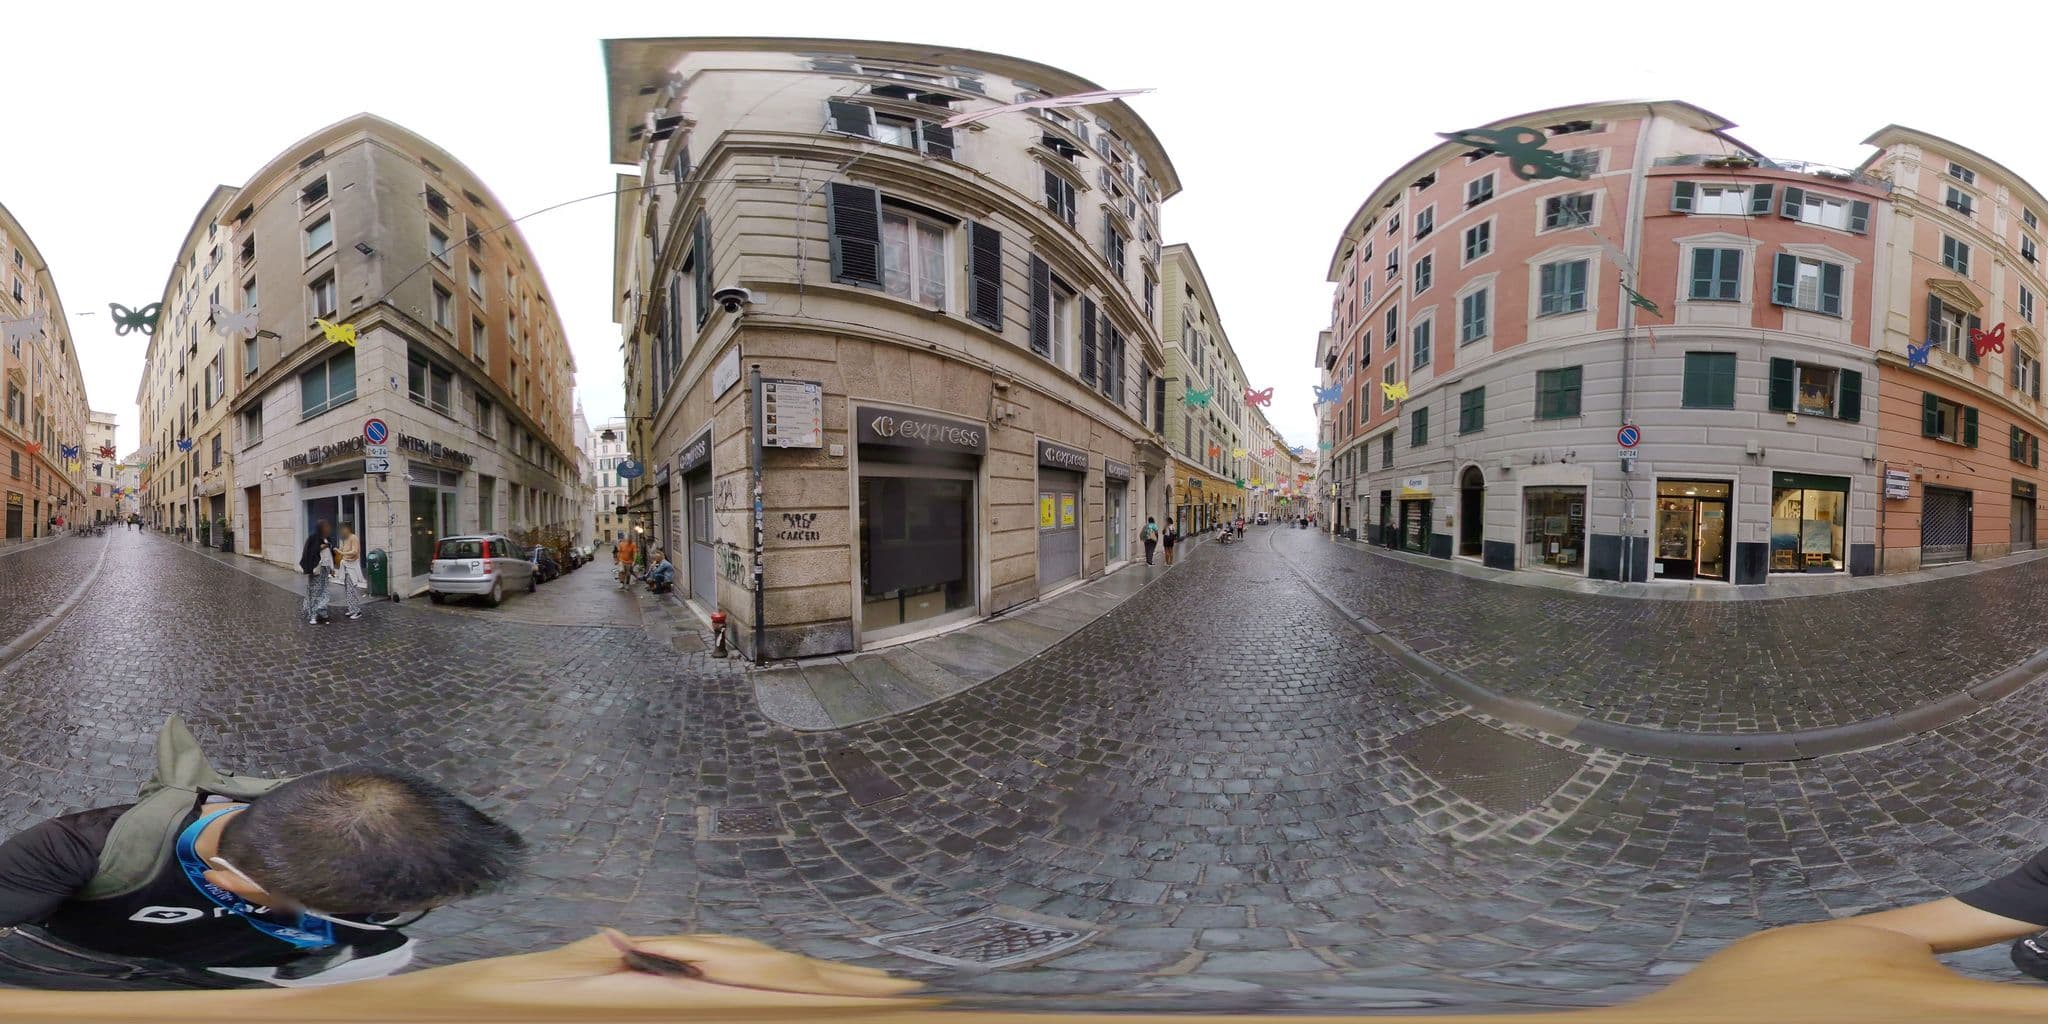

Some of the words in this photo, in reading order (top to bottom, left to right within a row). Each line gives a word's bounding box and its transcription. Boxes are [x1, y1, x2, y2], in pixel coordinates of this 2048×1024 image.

[398, 432, 430, 455] INTESA
[900, 420, 979, 447] express
[283, 453, 308, 469] INTESA
[1056, 450, 1087, 468] express
